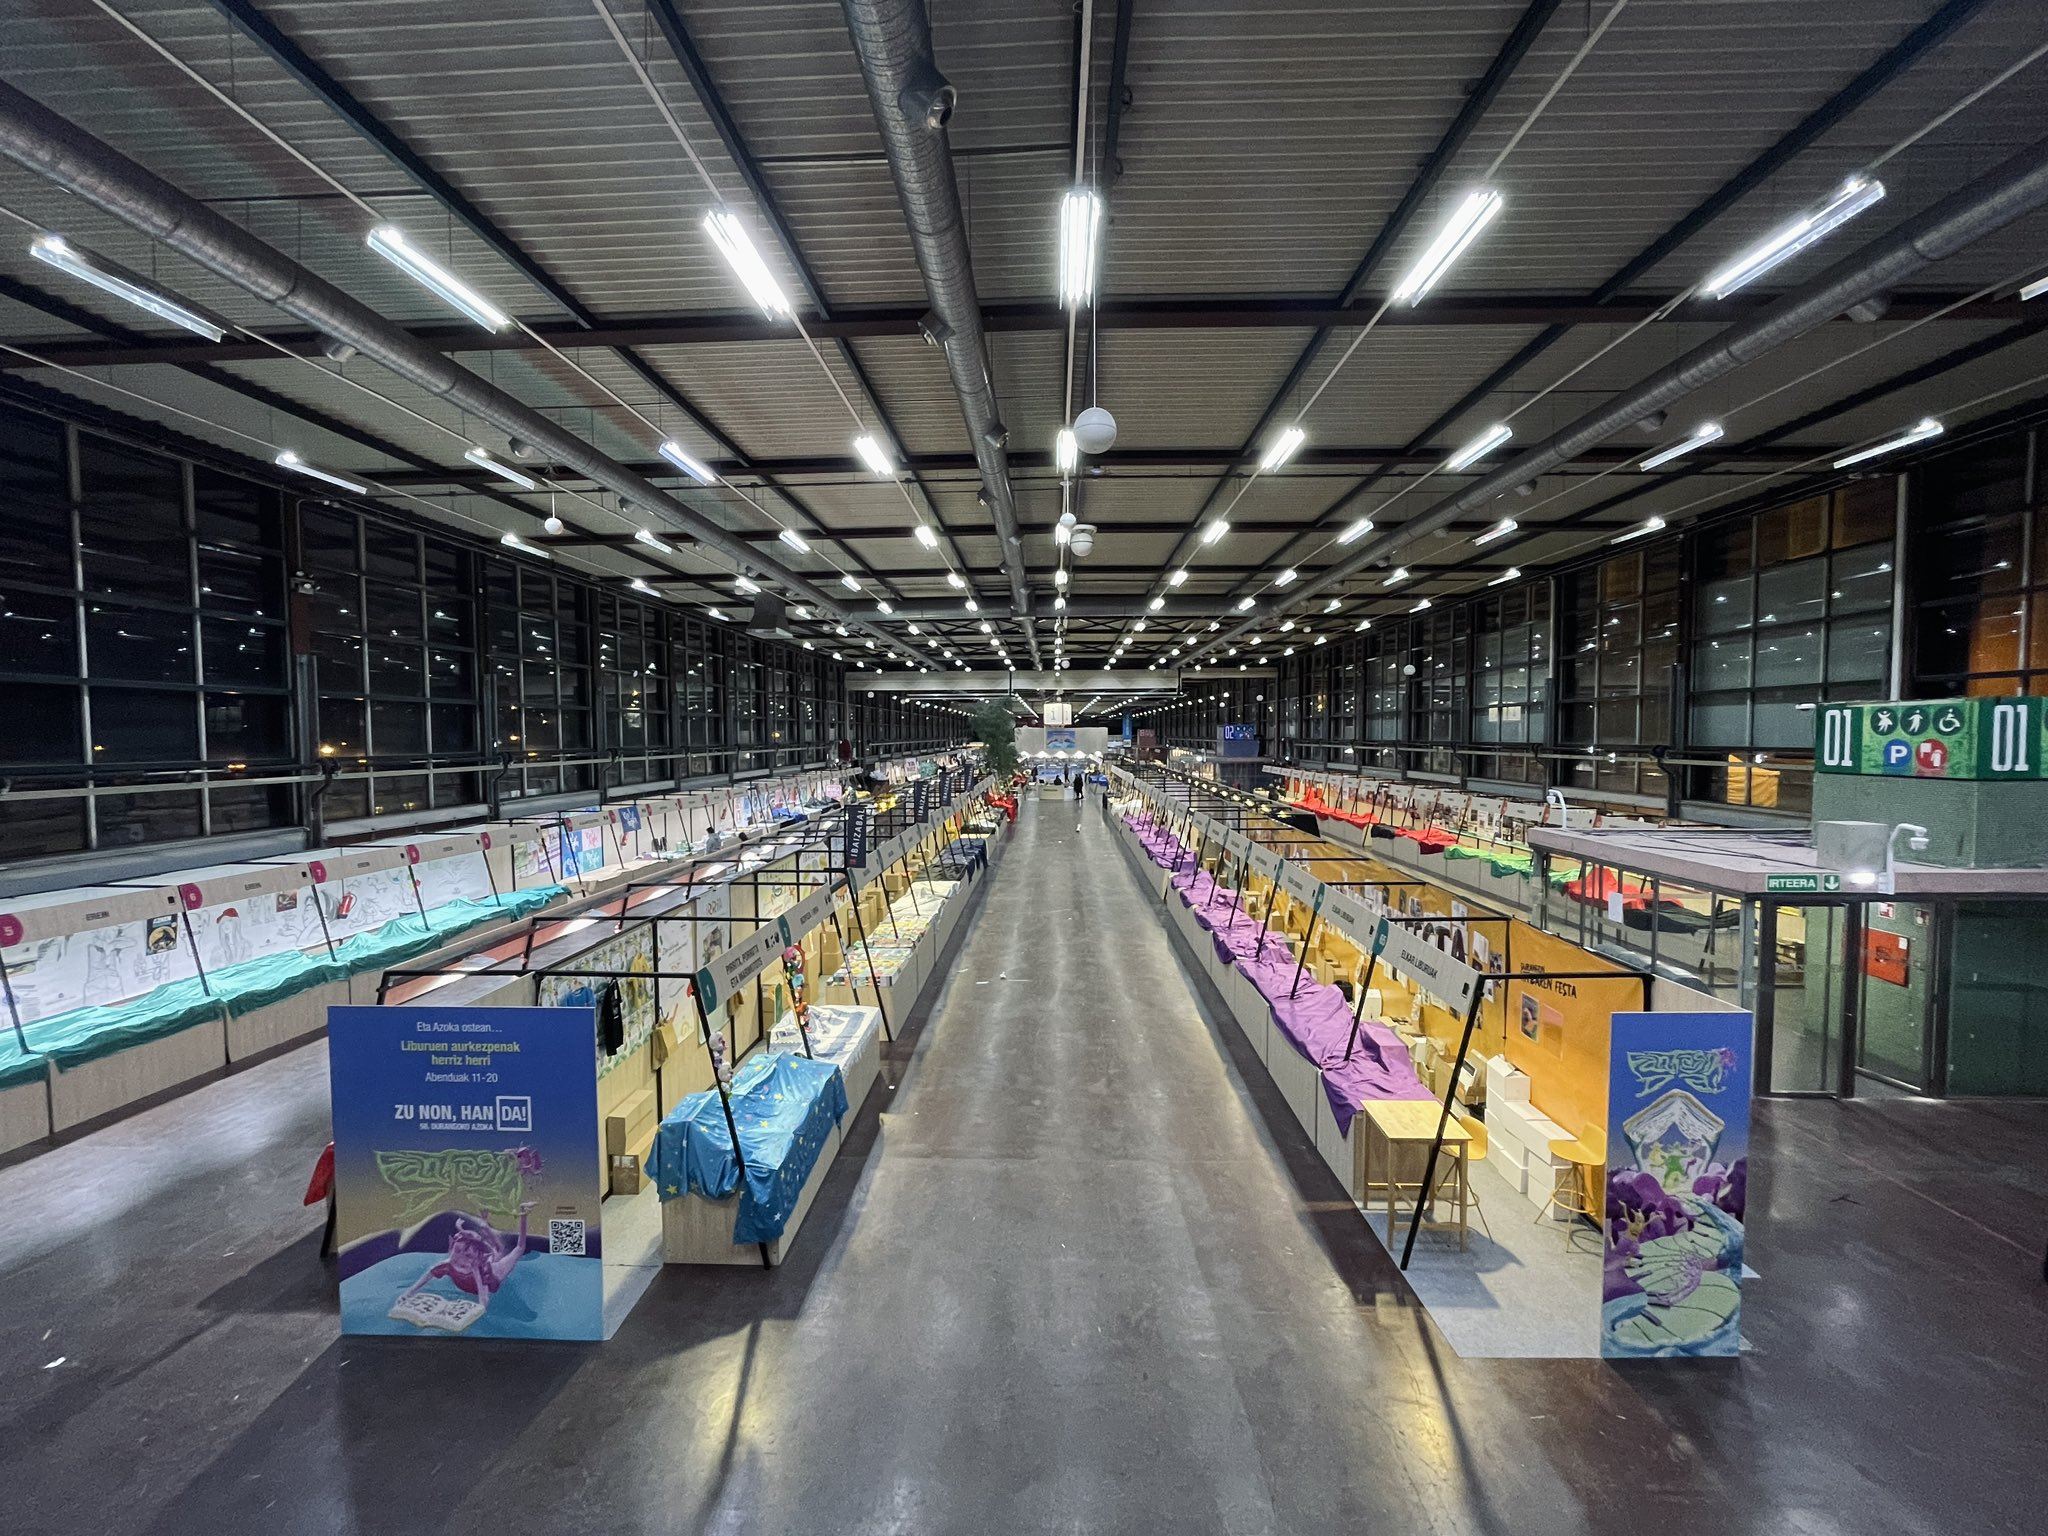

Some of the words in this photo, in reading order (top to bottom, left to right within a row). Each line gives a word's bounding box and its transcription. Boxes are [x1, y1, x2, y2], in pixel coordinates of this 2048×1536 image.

[1225, 725, 1234, 740] 02
[1823, 709, 1853, 767] 01
[1991, 704, 2029, 772] 01
[1890, 745, 1908, 764] P
[918, 784, 929, 817] IBAIZABAL
[850, 809, 866, 858] IBAIZABAL
[317, 869, 322, 877] 7
[1768, 877, 1816, 889] IRTEERA
[189, 893, 197, 901] 6
[4, 927, 14, 937] 5
[1555, 980, 1577, 999] FESTA
[417, 1021, 431, 1032] Eta
[432, 1022, 460, 1032] Azoka
[401, 1040, 448, 1051] Liburuen
[451, 1041, 521, 1054] aurkezpenak
[431, 1054, 462, 1066] herriz
[465, 1055, 491, 1066] herri
[425, 1071, 469, 1083] Abenduak
[472, 1072, 498, 1083] 11-20
[394, 1104, 414, 1120] ZU
[419, 1104, 457, 1122] NON,
[461, 1105, 494, 1121] HAN
[501, 1105, 527, 1122] DA!
